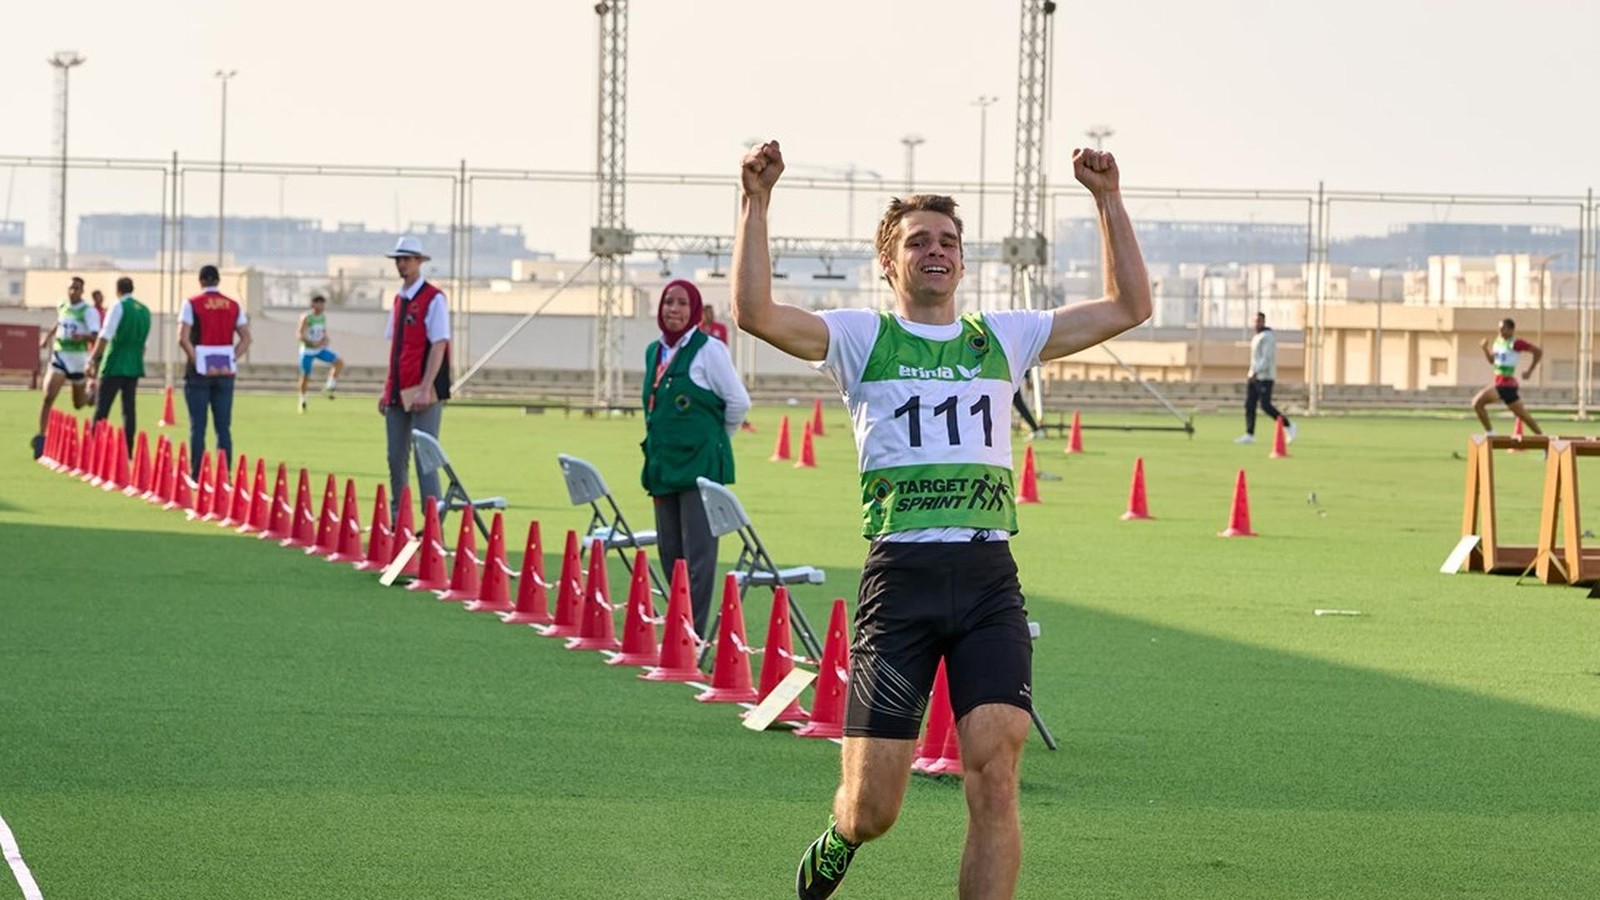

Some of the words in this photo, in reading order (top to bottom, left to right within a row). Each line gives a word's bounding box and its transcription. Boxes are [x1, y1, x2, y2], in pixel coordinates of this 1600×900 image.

[899, 364, 955, 379] erima
[894, 394, 993, 448] 111
[896, 478, 969, 495] TARGET
[895, 495, 967, 513] SPRINT
